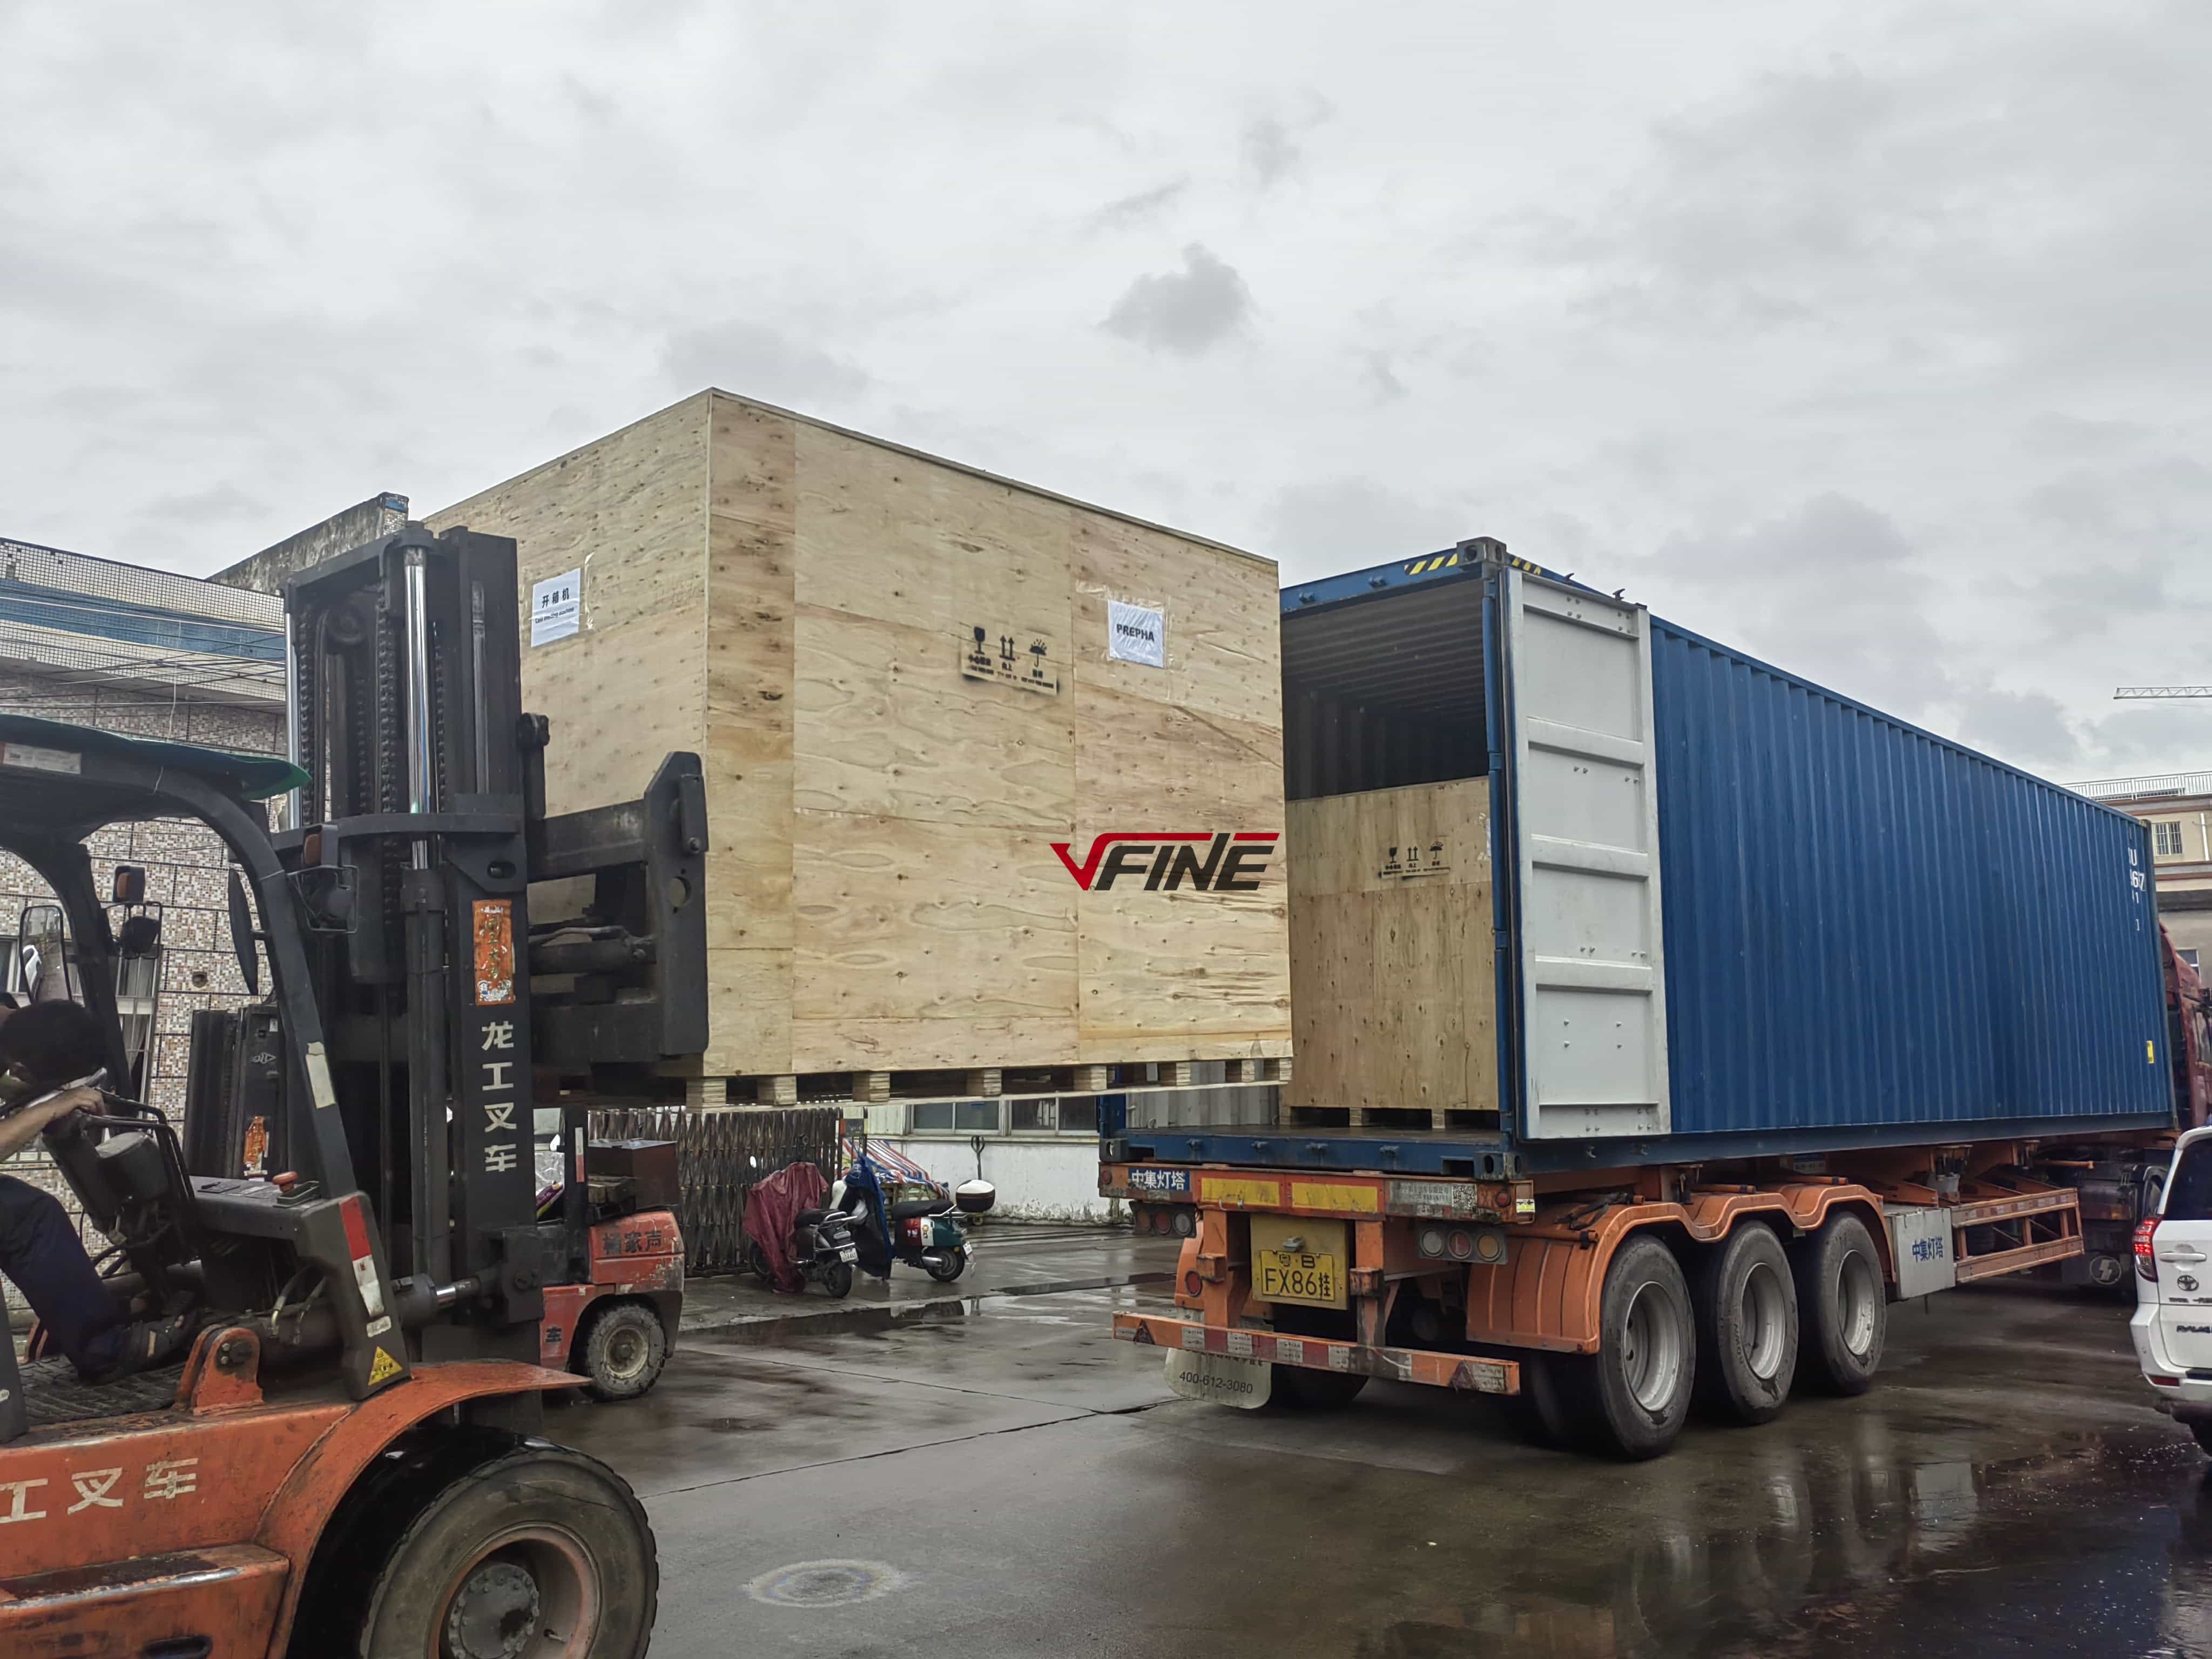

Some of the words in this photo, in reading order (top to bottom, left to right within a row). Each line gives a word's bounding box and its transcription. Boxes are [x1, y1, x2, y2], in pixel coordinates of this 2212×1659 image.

[542, 588, 569, 608] 开箱机
[1116, 624, 1155, 642] PREPHA
[481, 1020, 517, 1172] 龙工叉车
[1131, 1169, 1185, 1190] 中集灯塔
[1912, 1236, 1944, 1264] 中集灯塔
[1265, 1268, 1331, 1298] FX86挂
[1179, 1371, 1253, 1394] 400-612-3080
[0, 1458, 199, 1524] 工叉车
